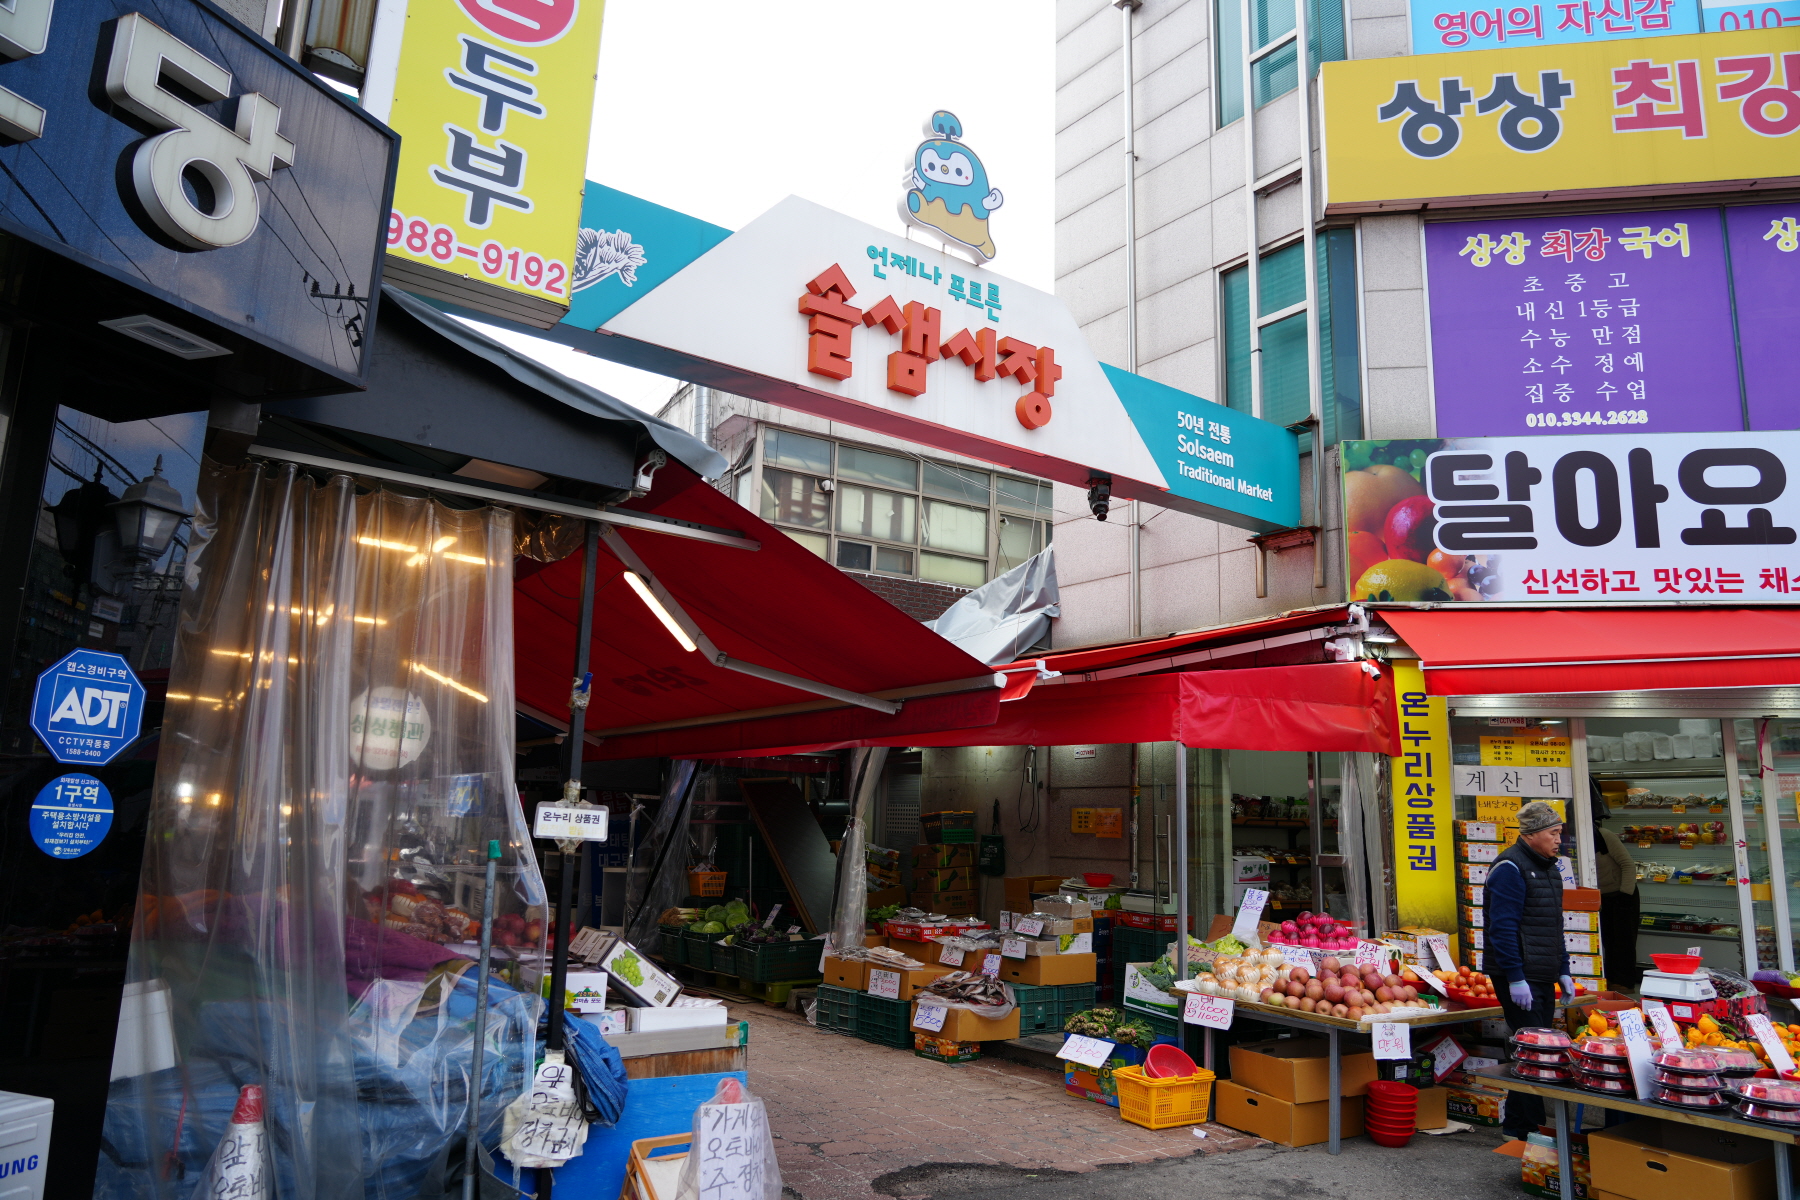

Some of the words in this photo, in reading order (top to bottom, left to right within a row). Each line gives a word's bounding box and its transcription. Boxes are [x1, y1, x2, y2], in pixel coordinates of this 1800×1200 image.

[1434, 6, 1540, 46] 영어의
[1558, 0, 1671, 36] 자신감
[1380, 72, 1572, 157] 상상
[1614, 53, 1800, 138] 최강
[434, 38, 544, 226] 두부
[1459, 232, 1530, 267] 상상
[1541, 229, 1610, 262] 최강
[1619, 223, 1691, 258] 국어
[866, 244, 942, 286] 언제나
[948, 272, 1003, 322] 푸르른
[798, 262, 1062, 430] 솔샘시장
[1177, 410, 1205, 436] 50년
[1208, 421, 1232, 445] 전통
[1526, 410, 1648, 428] 010.3344.2628
[1177, 433, 1235, 468] Solsaem
[1177, 460, 1235, 491] Traditional
[1237, 478, 1274, 502] Market
[1431, 446, 1797, 551] 달아요
[1522, 567, 1640, 595] 신선하고
[1653, 567, 1744, 594] 맛있는
[66, 661, 127, 679] 캡스경비구역
[50, 686, 130, 728] ADT
[58, 736, 111, 749] CCTV작동중
[65, 748, 101, 757] 1588-6400
[55, 784, 99, 805] 1구역
[1401, 692, 1437, 871] 온누리상품권
[543, 811, 572, 823] 온누리
[574, 813, 601, 824] 상품권
[1360, 942, 1381, 954] 사과
[1062, 1040, 1103, 1059] 2500
